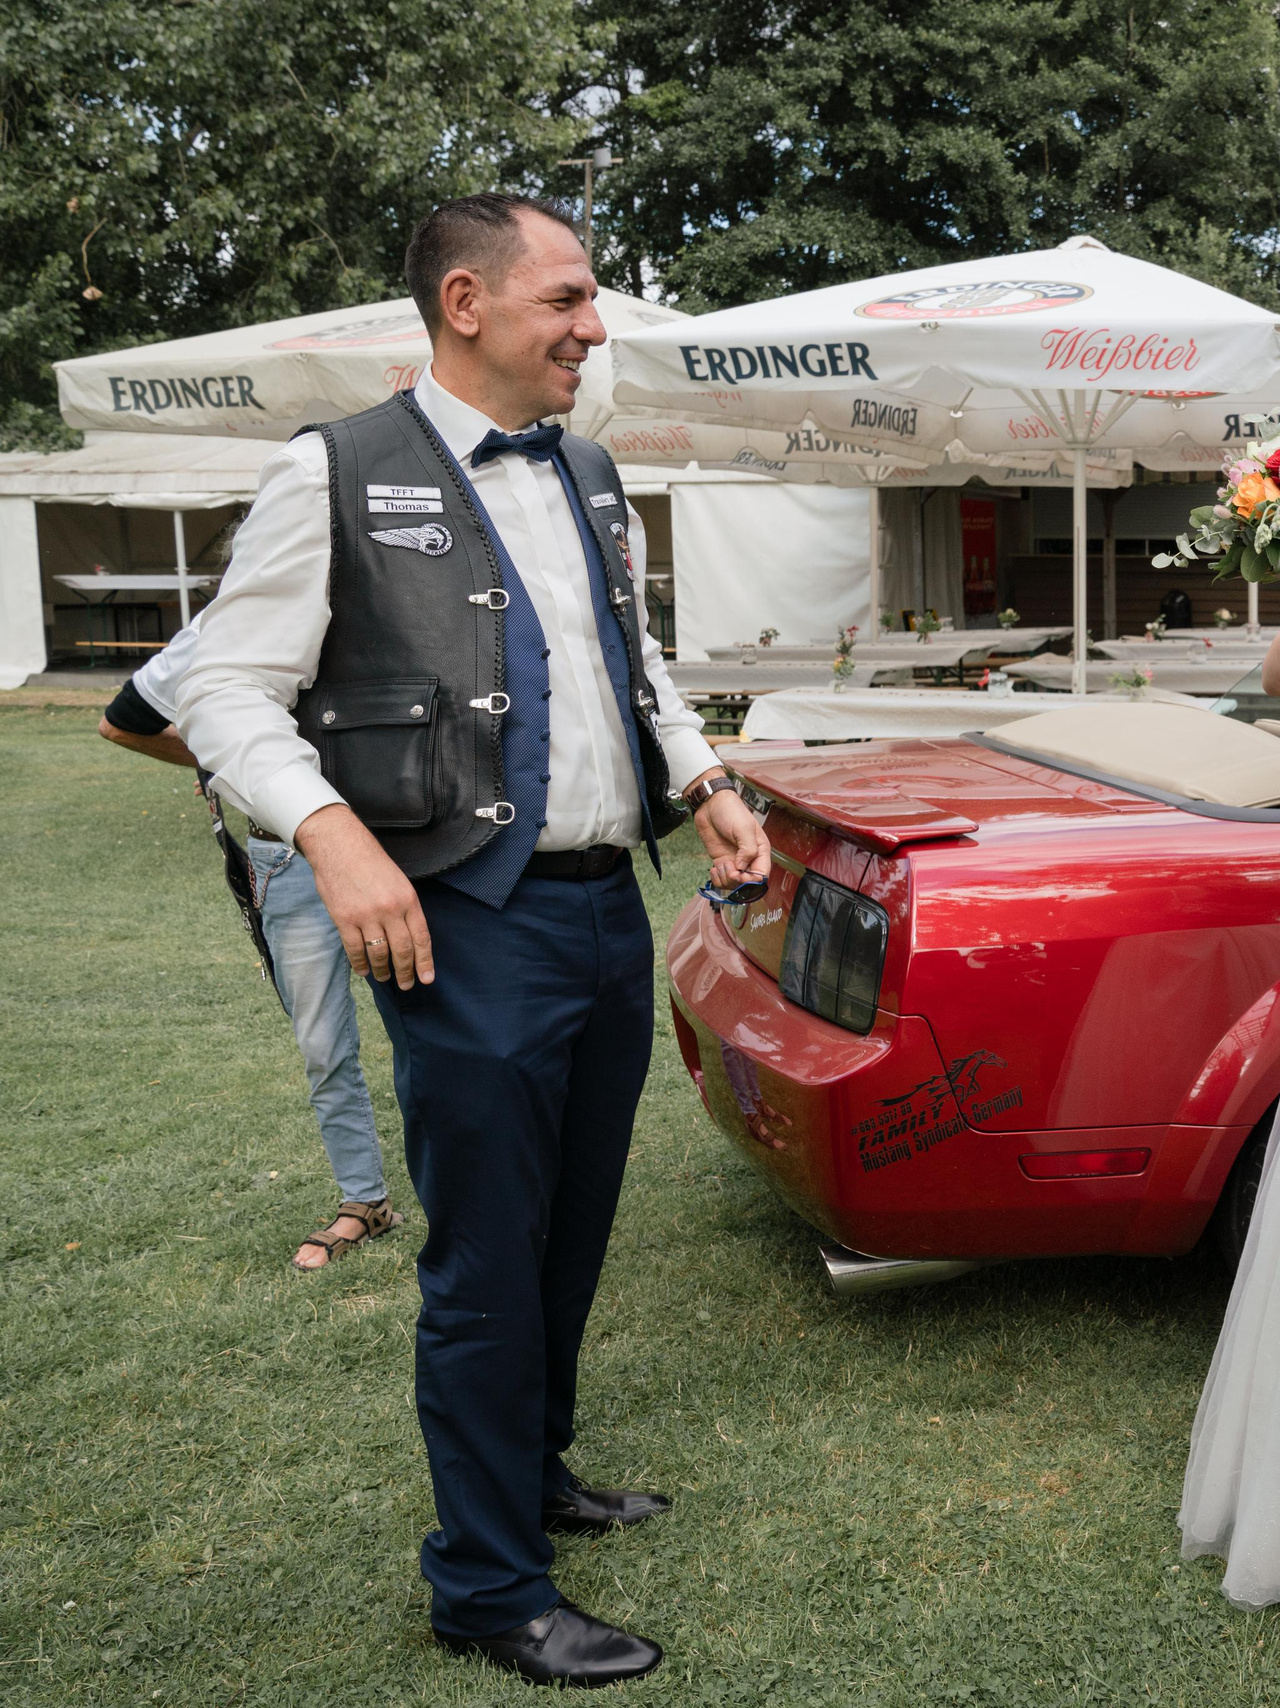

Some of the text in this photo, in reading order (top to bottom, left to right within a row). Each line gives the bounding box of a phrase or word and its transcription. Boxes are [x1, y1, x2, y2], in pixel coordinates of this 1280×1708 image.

[678, 341, 880, 384] ERDINGER
[1042, 327, 1201, 381] Weißbier
[109, 375, 266, 415] ERDINGER
[383, 502, 430, 511] Thomas
[858, 1103, 943, 1150] FAMILY
[860, 1140, 912, 1173] Mustang
